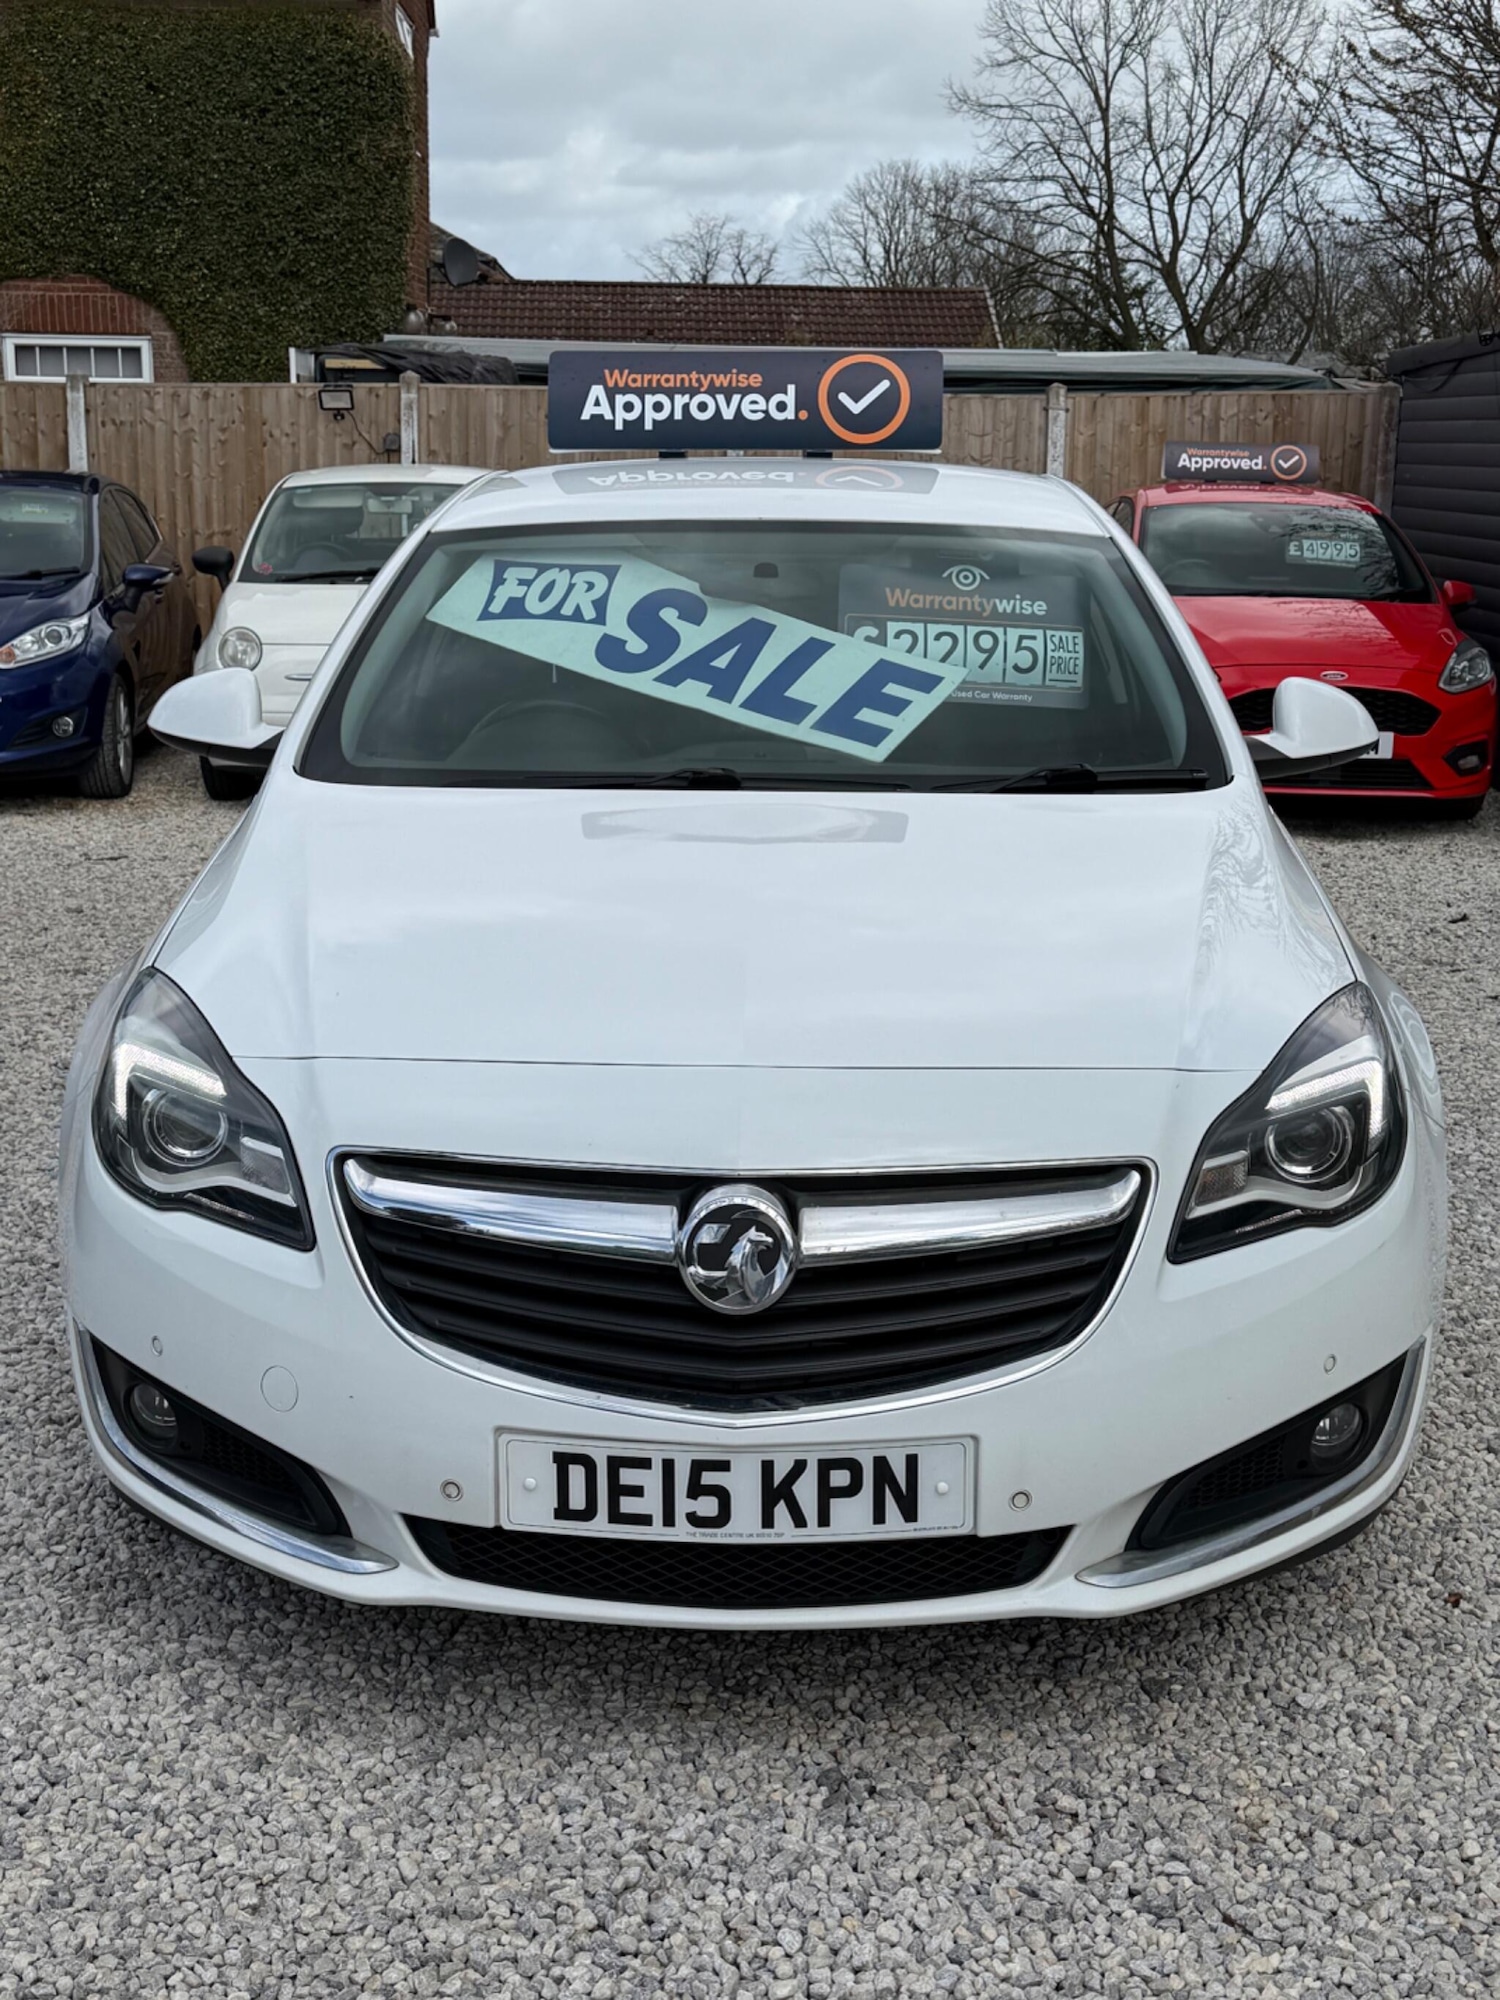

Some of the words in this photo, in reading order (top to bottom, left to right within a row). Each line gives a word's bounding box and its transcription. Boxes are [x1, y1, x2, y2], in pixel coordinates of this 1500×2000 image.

[604, 368, 763, 392] Warrantywise
[580, 384, 809, 431] Approved.
[1177, 453, 1268, 472] Approved.
[1186, 447, 1250, 458] Warrantywise
[1288, 541, 1359, 558] £4995
[885, 587, 1048, 617] Warrantywise
[853, 625, 1039, 675] 2295
[1049, 634, 1080, 654] SALE
[487, 566, 609, 622] FOR
[595, 588, 945, 747] SALE
[1048, 656, 1079, 675] PRICE
[974, 690, 990, 699] Car
[992, 690, 1033, 703] Warranty
[552, 1450, 732, 1529] DE15
[761, 1453, 919, 1529] KPN
